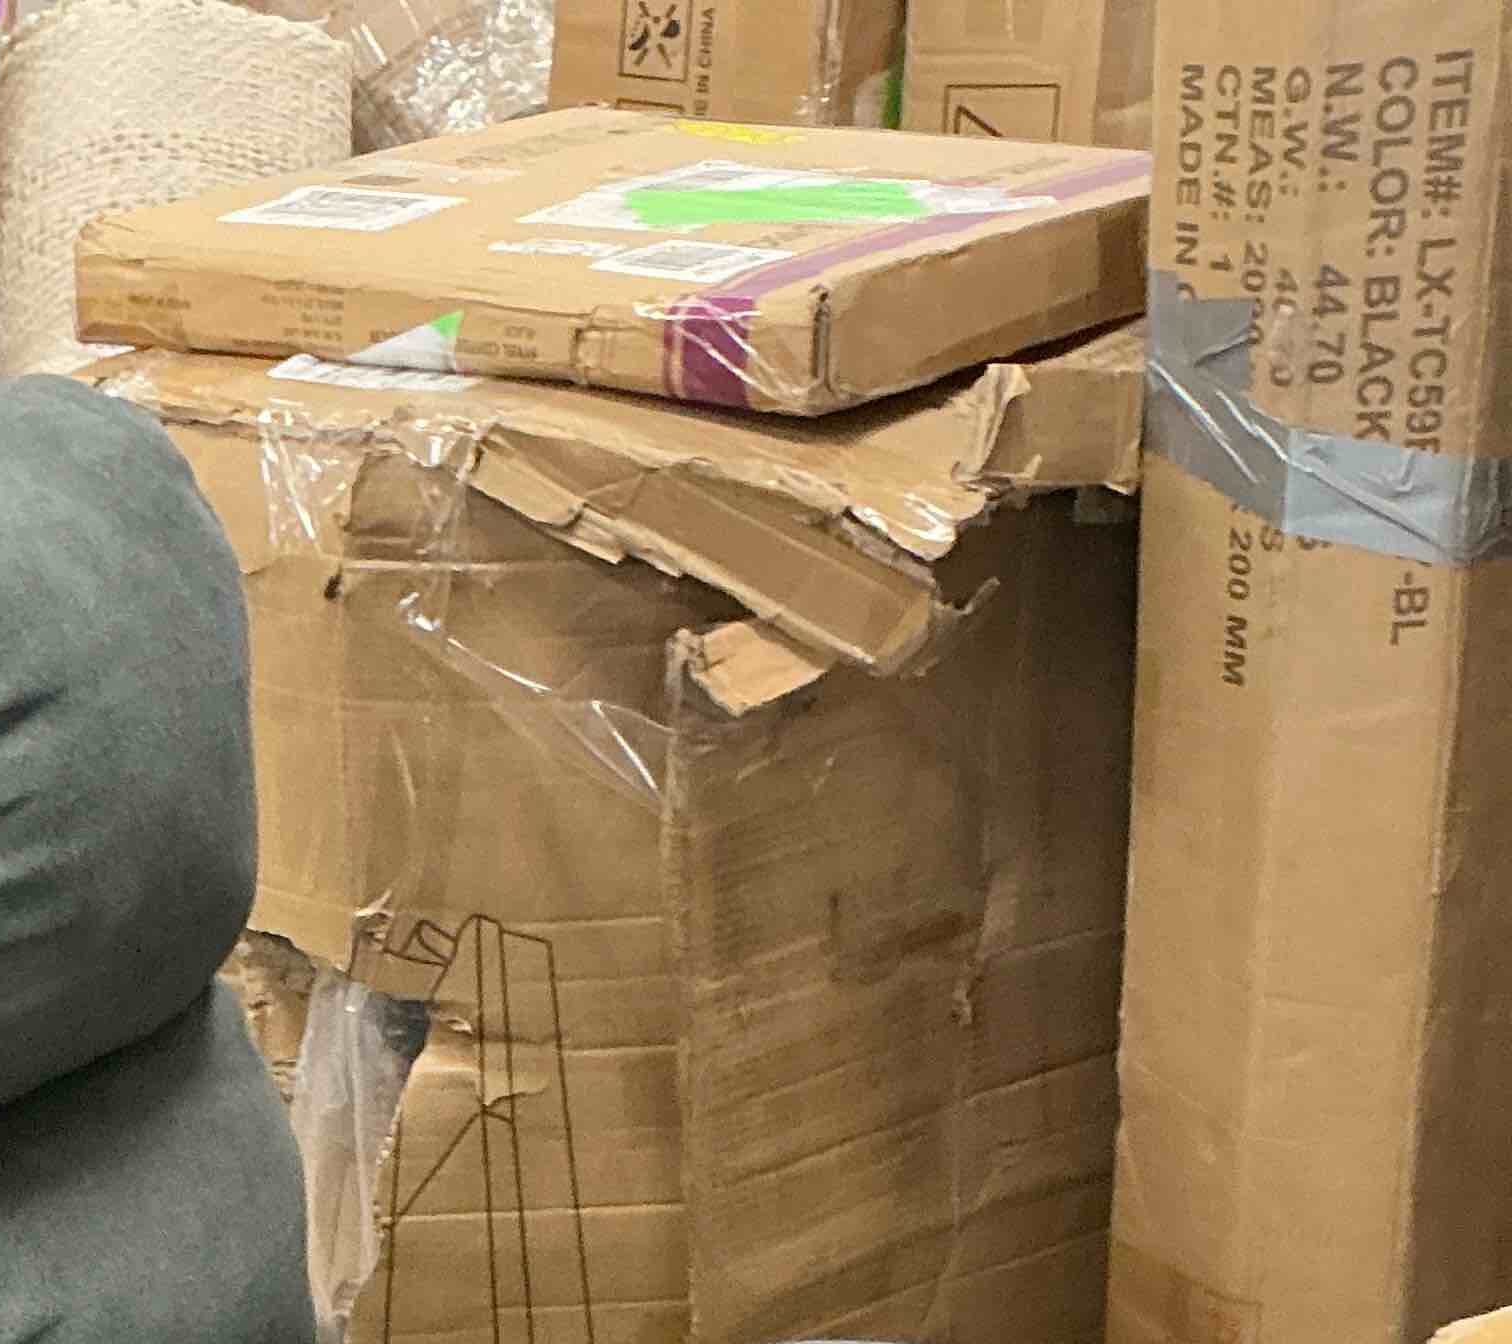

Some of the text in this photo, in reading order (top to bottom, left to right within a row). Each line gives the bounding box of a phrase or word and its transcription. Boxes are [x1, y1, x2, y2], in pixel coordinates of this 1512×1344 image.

[699, 7, 714, 68] CHINA
[1176, 64, 1205, 206] MADE
[1209, 64, 1242, 273] CTN.#: 1
[1245, 66, 1277, 224] MEAS:
[1278, 66, 1311, 198] G.W.:
[1420, 48, 1474, 220] ITEM#:
[1175, 222, 1199, 266] IN
[1307, 62, 1365, 384] N.W.: 44.70
[1355, 55, 1419, 441] COLOR: BLACK
[1226, 526, 1253, 602] 200
[1222, 616, 1248, 688] MM
